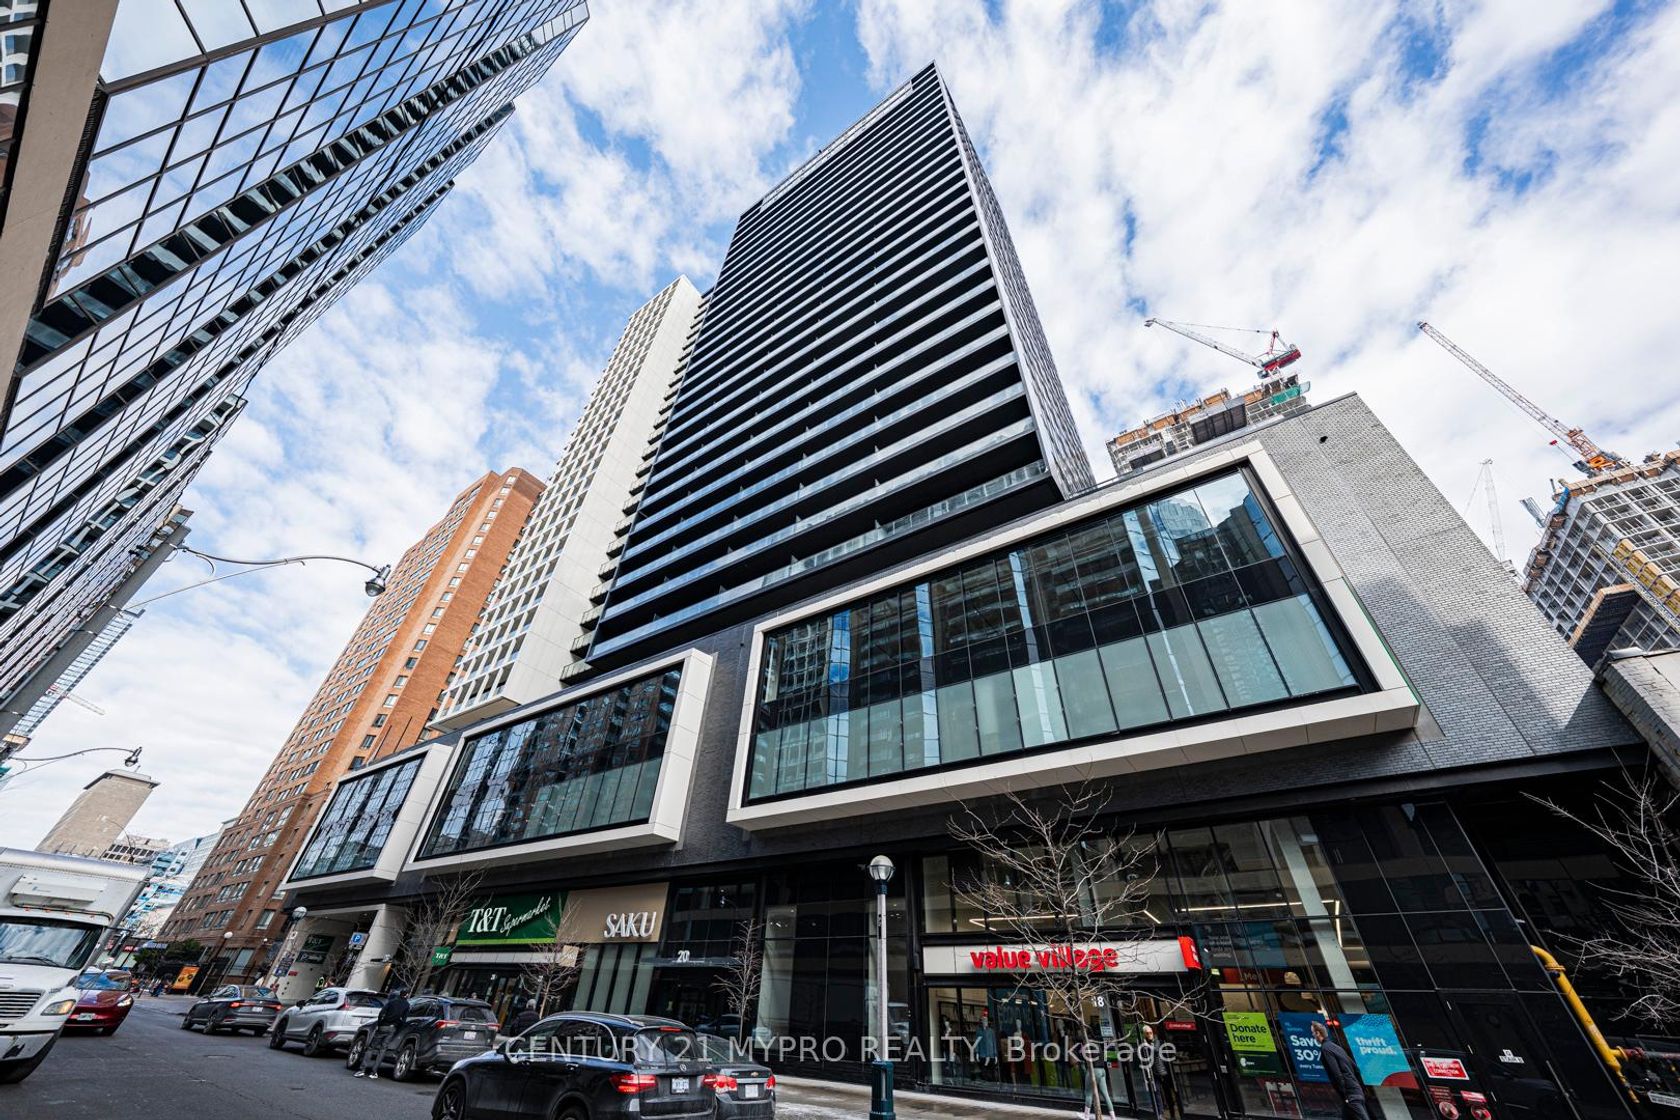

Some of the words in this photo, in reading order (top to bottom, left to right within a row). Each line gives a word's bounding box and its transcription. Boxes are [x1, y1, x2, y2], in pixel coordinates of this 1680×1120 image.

[468, 907, 507, 933] T&T
[500, 896, 551, 936] Supermarket
[604, 911, 657, 938] SAKU
[677, 950, 690, 963] 20
[970, 945, 1032, 970] value
[1037, 942, 1119, 973] village
[1092, 996, 1105, 1008] 18
[1229, 1023, 1267, 1034] Donate
[1232, 1032, 1257, 1043] here
[1355, 1036, 1387, 1047] thrift
[1360, 1045, 1397, 1056] proud.
